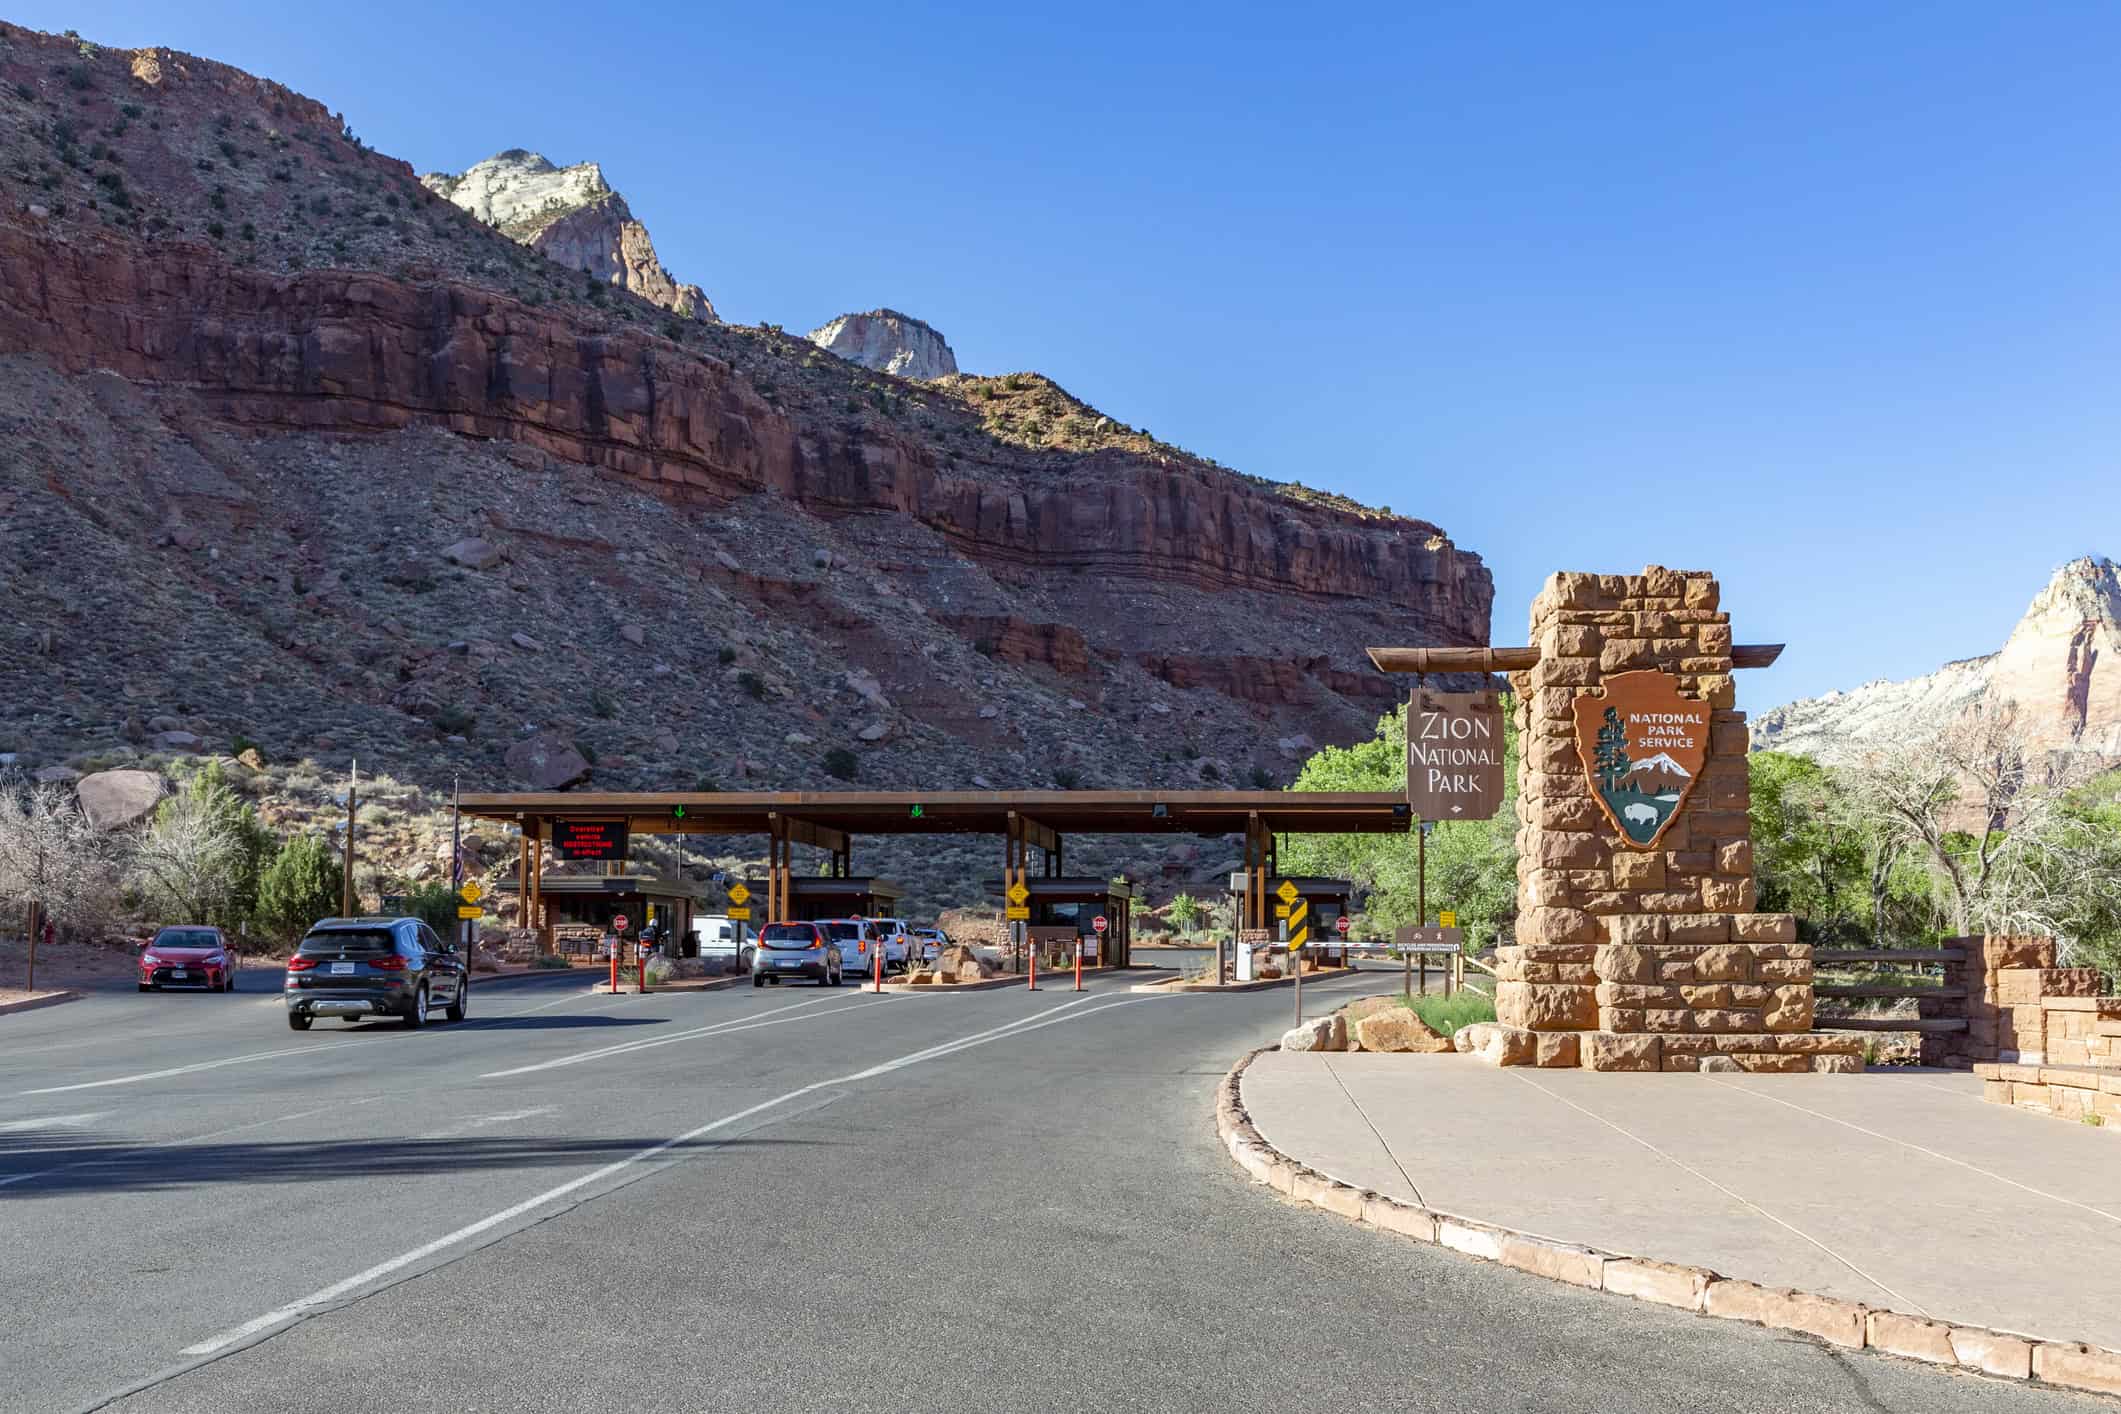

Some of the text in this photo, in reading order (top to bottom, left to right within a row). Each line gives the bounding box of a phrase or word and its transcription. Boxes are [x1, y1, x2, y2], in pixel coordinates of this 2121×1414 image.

[1420, 712, 1491, 739] ZION
[1630, 713, 1703, 724] NATIONAL
[1648, 726, 1685, 736] PARK
[1639, 737, 1694, 748] SERVICE
[1410, 742, 1501, 766] NATIONAL
[1428, 768, 1483, 793] PARK
